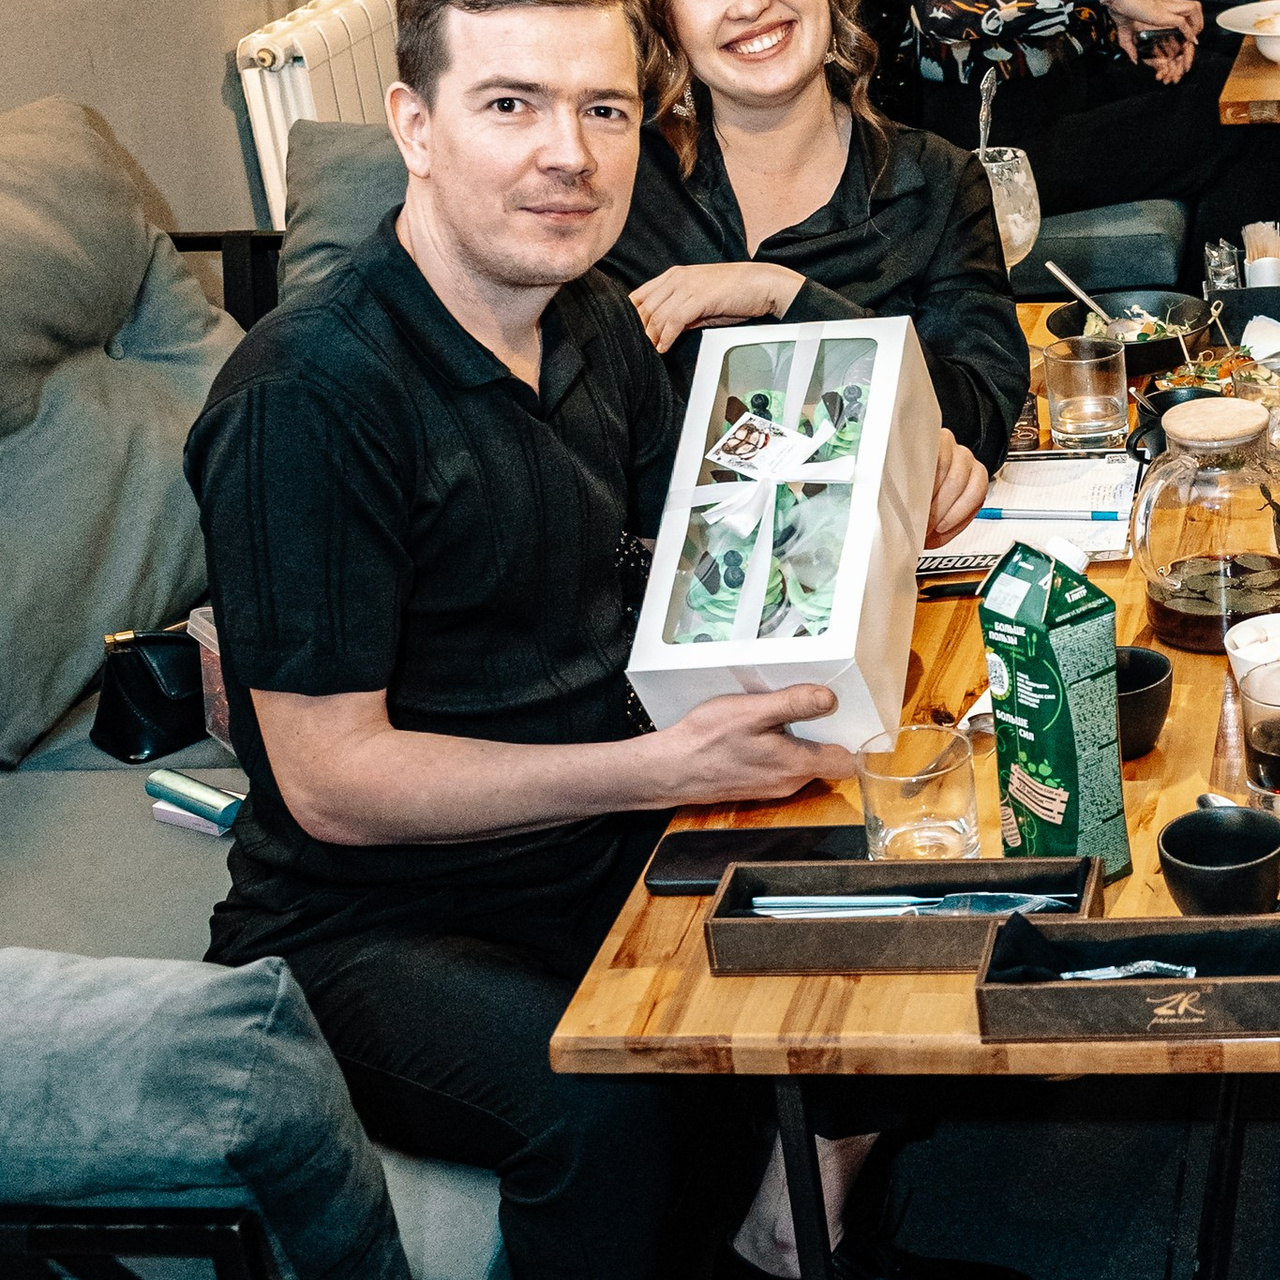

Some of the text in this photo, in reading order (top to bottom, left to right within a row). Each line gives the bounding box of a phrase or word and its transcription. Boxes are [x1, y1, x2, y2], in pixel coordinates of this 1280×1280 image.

[994, 621, 1026, 637] БОЛЬШЕ
[989, 631, 1018, 646] ПОЛЬЗЫ
[995, 709, 1029, 729] БОЛЬШЕ
[1018, 728, 1035, 742] СИЛ
